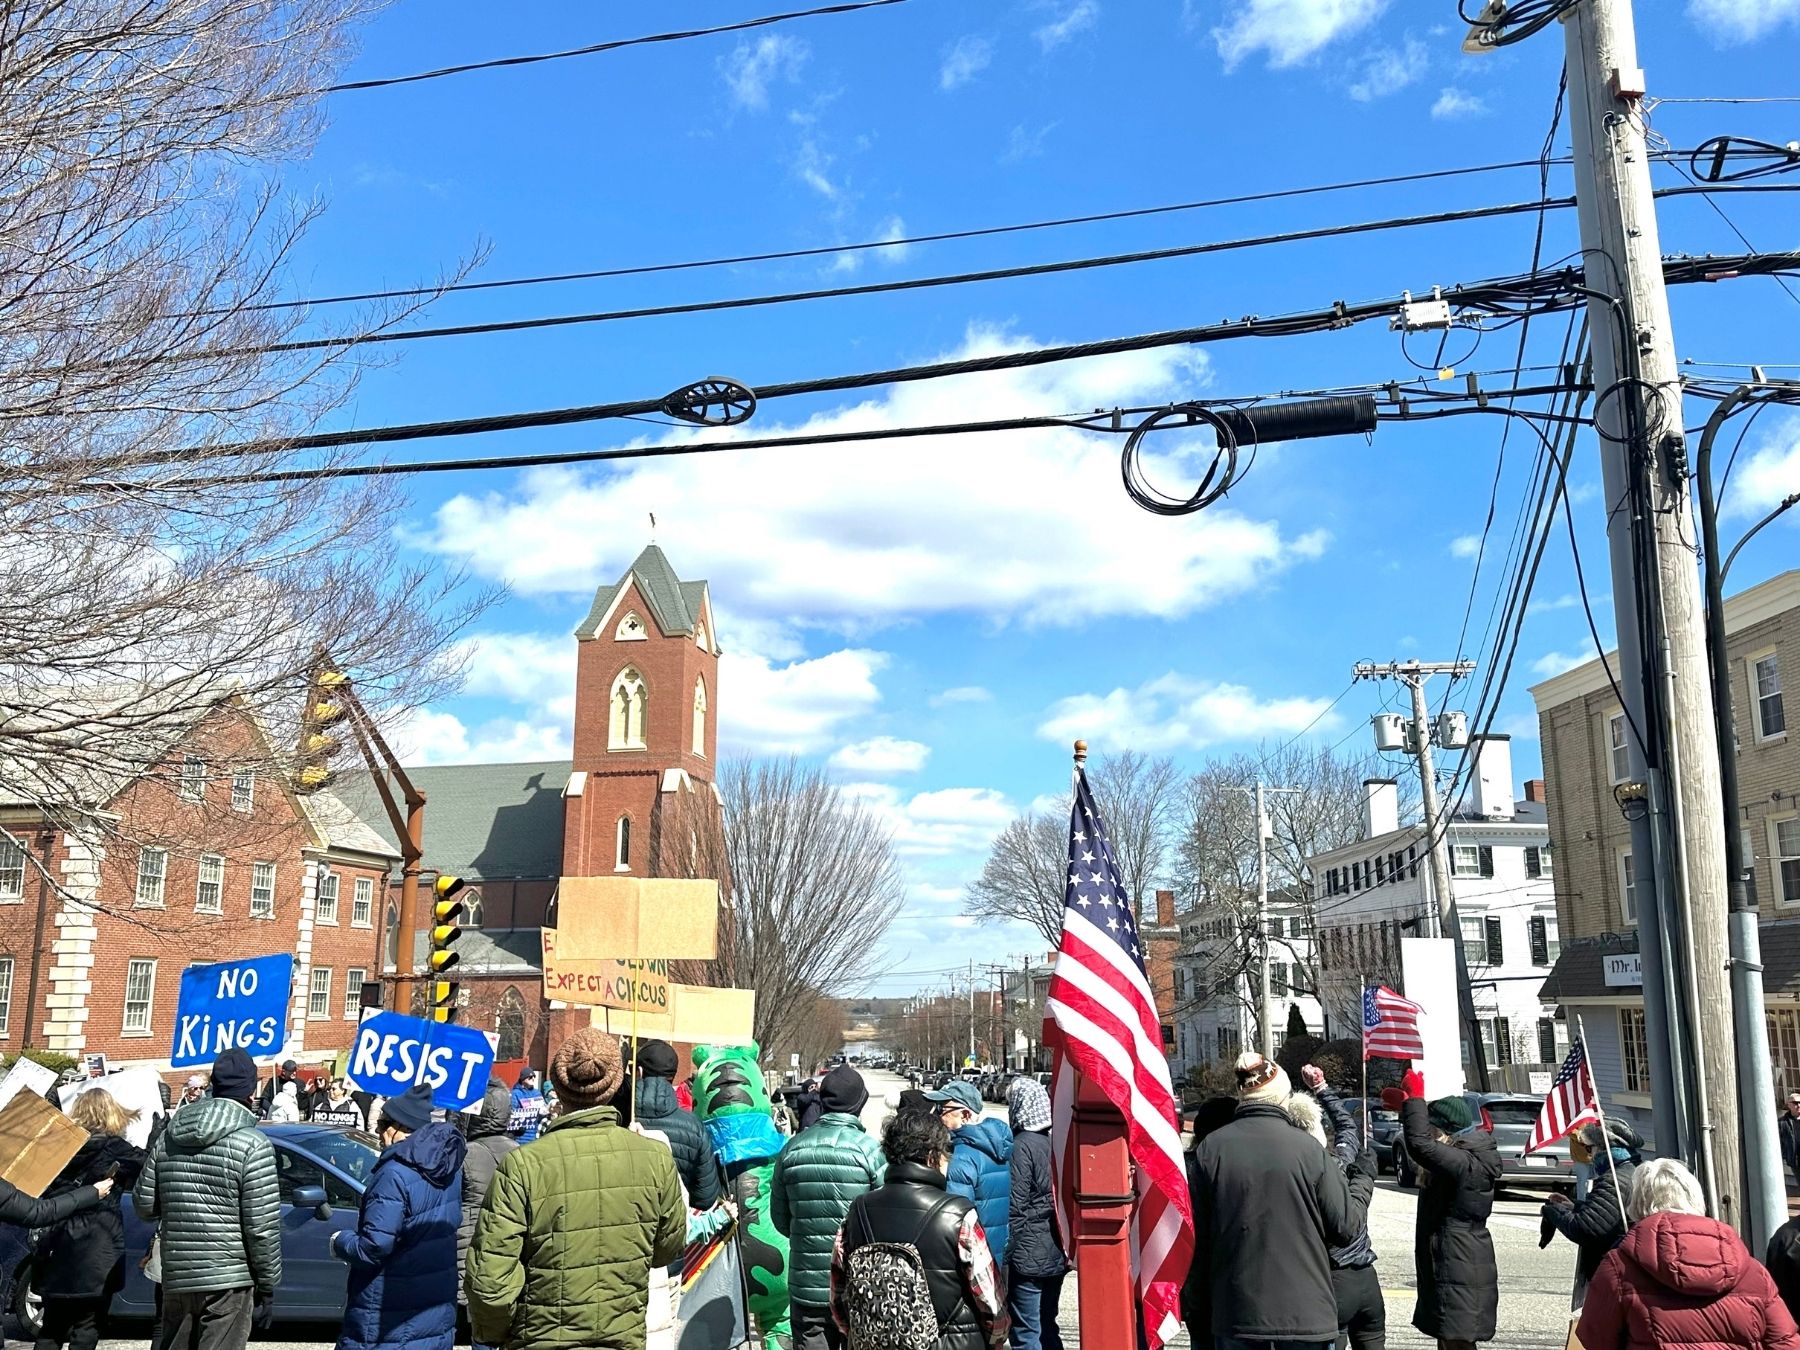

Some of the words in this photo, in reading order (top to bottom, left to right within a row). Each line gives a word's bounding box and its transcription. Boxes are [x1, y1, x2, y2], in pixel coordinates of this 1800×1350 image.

[1609, 959, 1633, 973] Mr.
[216, 968, 258, 999] NO
[545, 966, 602, 992] EXPECT
[605, 980, 616, 1000] A
[616, 976, 667, 1007] CIRCUS
[353, 1028, 485, 1100] RESIST
[314, 1111, 328, 1121] NO
[328, 1112, 356, 1122] KINGS
